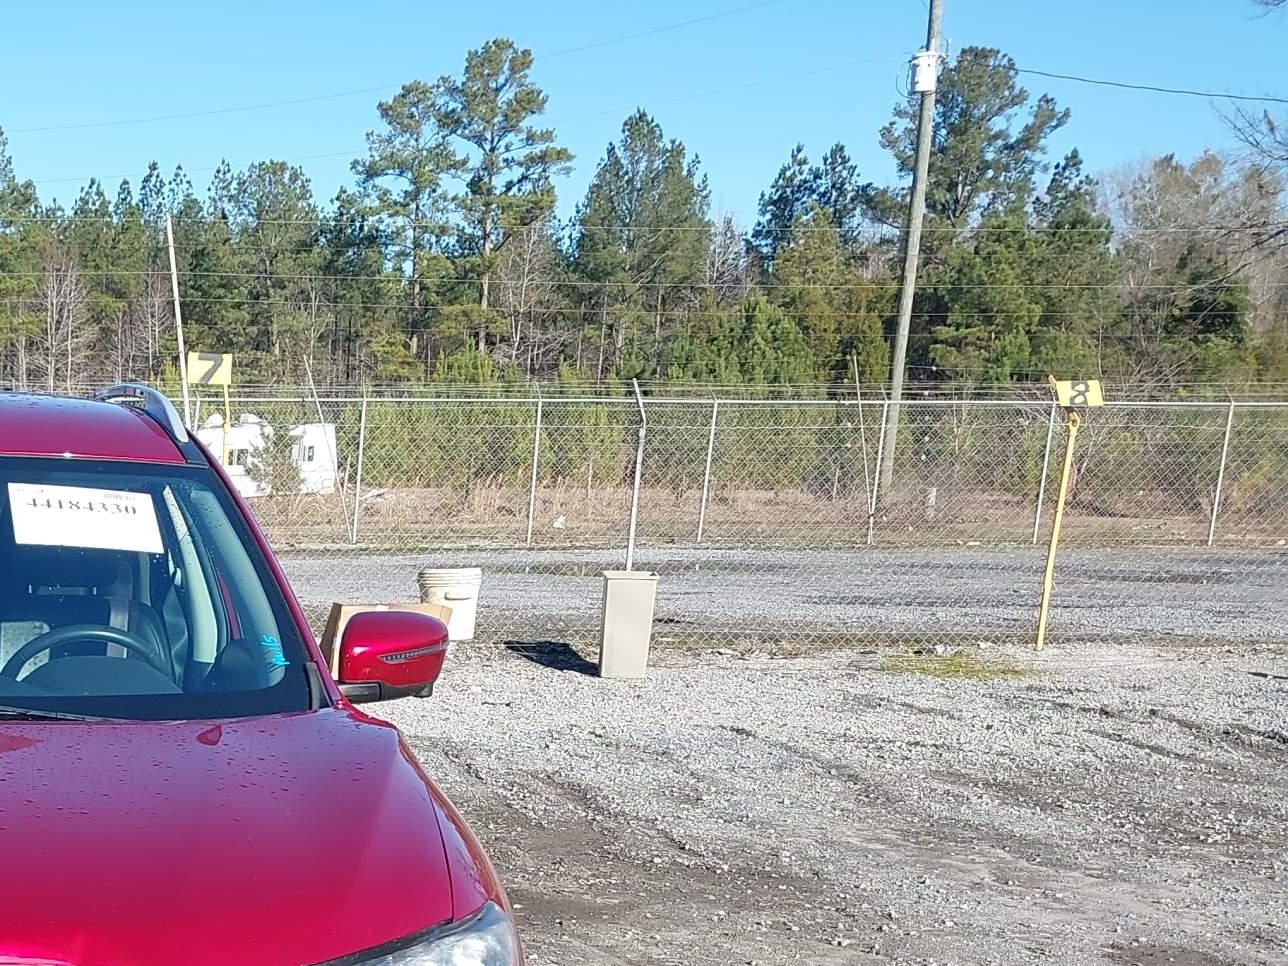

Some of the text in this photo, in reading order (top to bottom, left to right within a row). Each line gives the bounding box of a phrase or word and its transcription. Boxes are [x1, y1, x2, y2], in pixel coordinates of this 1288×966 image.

[197, 352, 224, 384] 7
[1069, 380, 1090, 407] 8
[25, 497, 137, 515] 44184330
